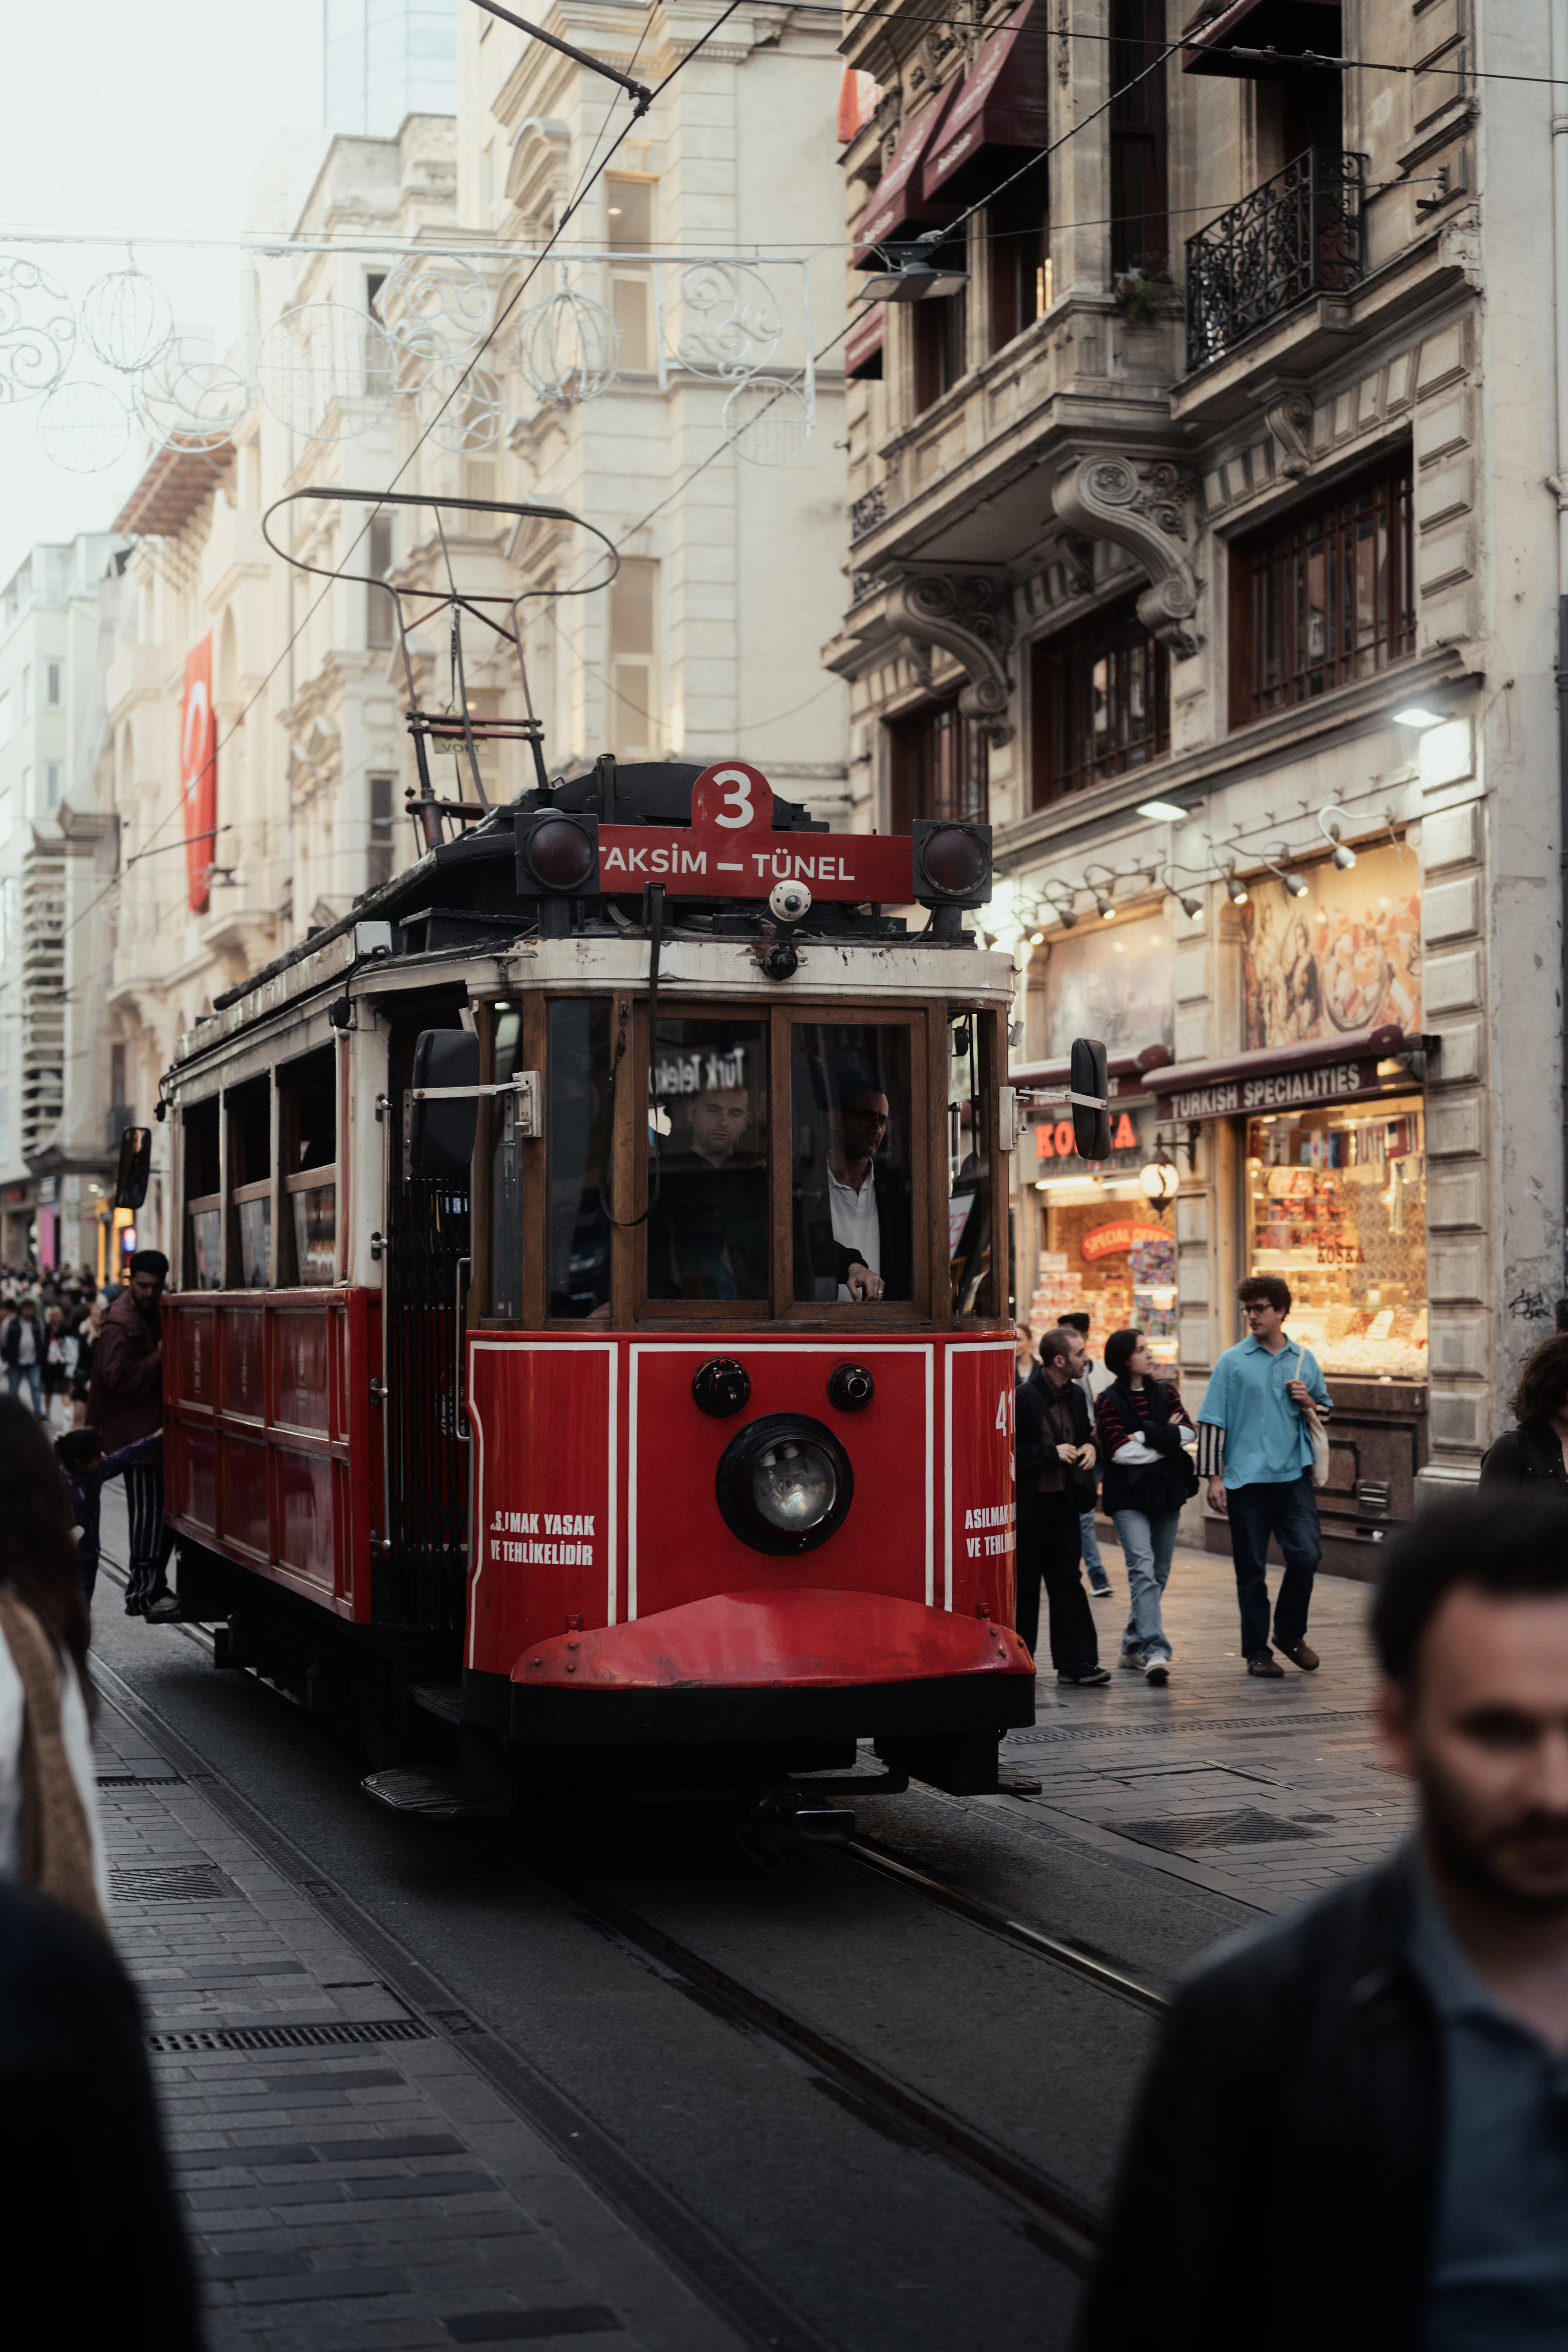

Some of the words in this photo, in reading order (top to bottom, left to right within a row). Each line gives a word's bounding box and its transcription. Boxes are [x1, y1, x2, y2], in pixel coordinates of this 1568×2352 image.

[712, 770, 754, 829] 3
[752, 848, 855, 880] TÜNEL
[1171, 1084, 1238, 1119] TURKISH
[1244, 1063, 1360, 1107] SPECIALITIES
[1318, 1245, 1365, 1263] KOSKA
[543, 1514, 595, 1536] YASAK
[965, 1504, 1009, 1529] ASILMAK
[490, 1539, 501, 1560] VE
[502, 1539, 593, 1565] TEHLİKELİDİR
[966, 1537, 981, 1558] VE
